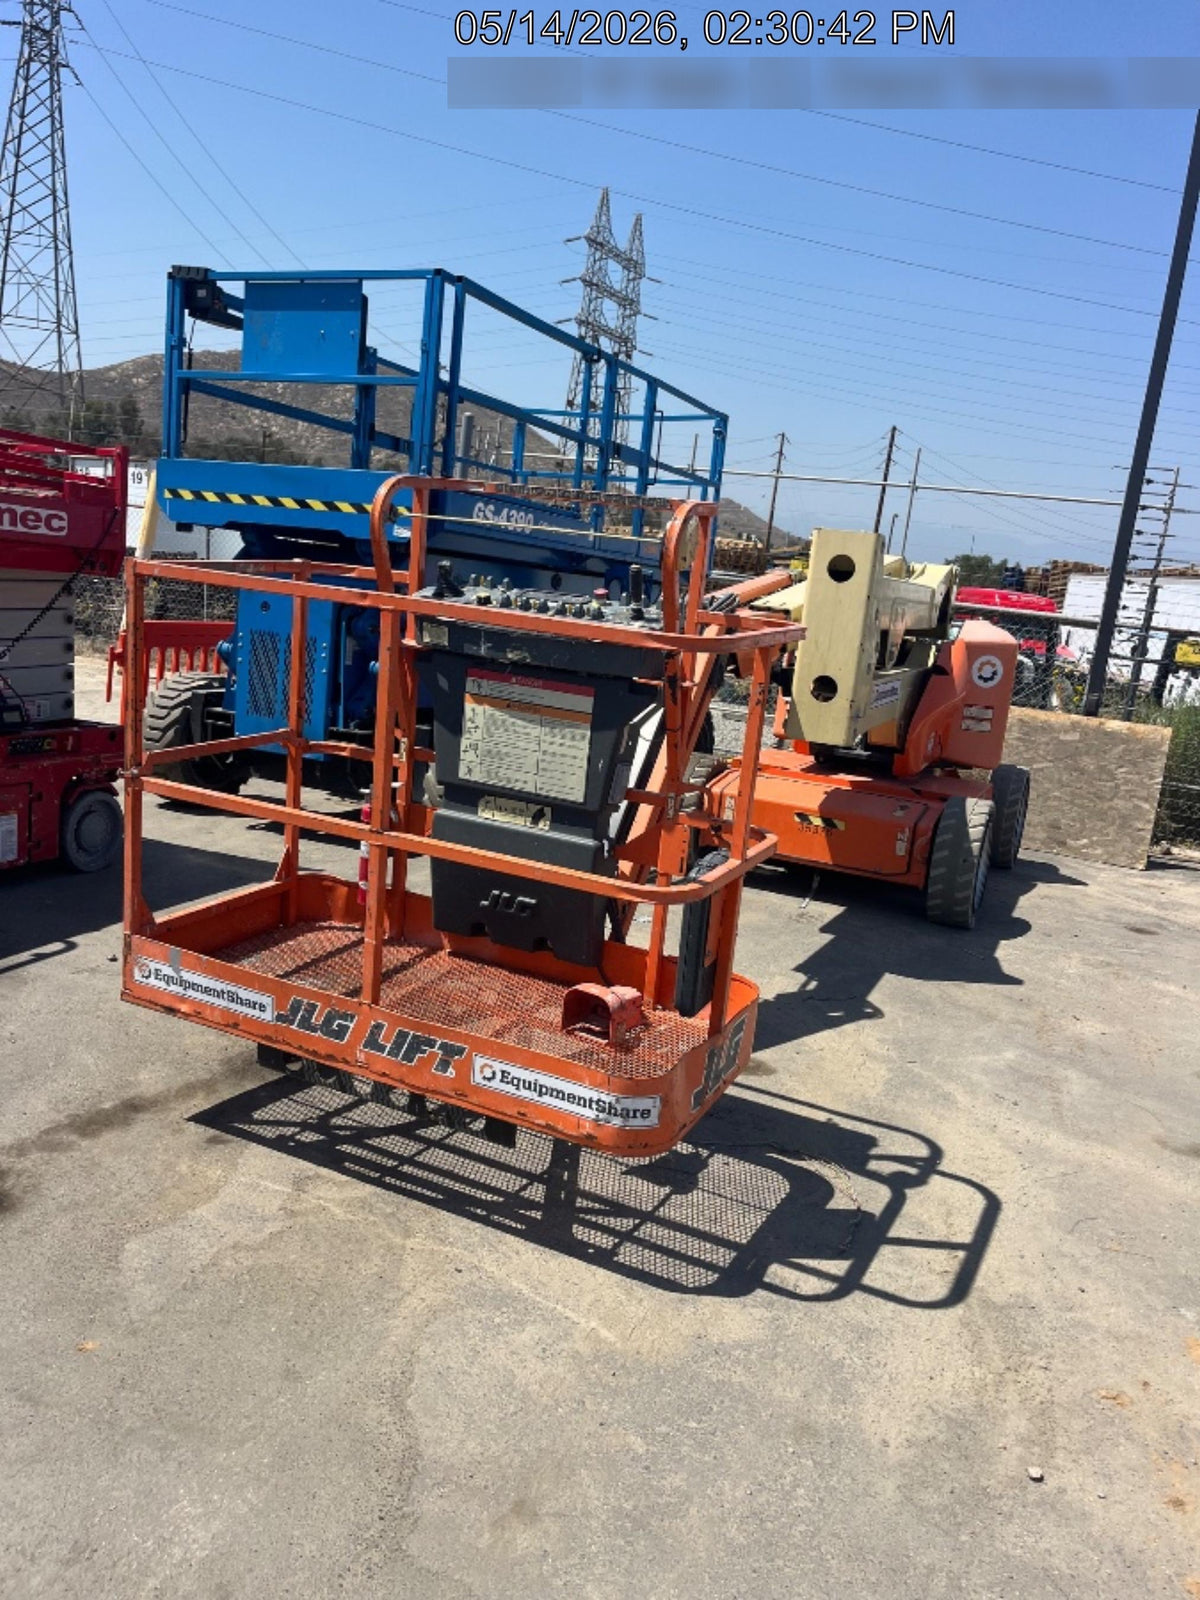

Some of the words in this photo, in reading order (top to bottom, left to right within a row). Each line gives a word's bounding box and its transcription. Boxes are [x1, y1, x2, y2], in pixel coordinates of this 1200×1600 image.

[131, 470, 144, 484] 19
[479, 889, 537, 918] JLG
[153, 966, 268, 1014] EquipmentShare
[274, 995, 358, 1044] JLG
[360, 1019, 470, 1078] LIFT
[499, 1068, 652, 1121] EquipmentShare
